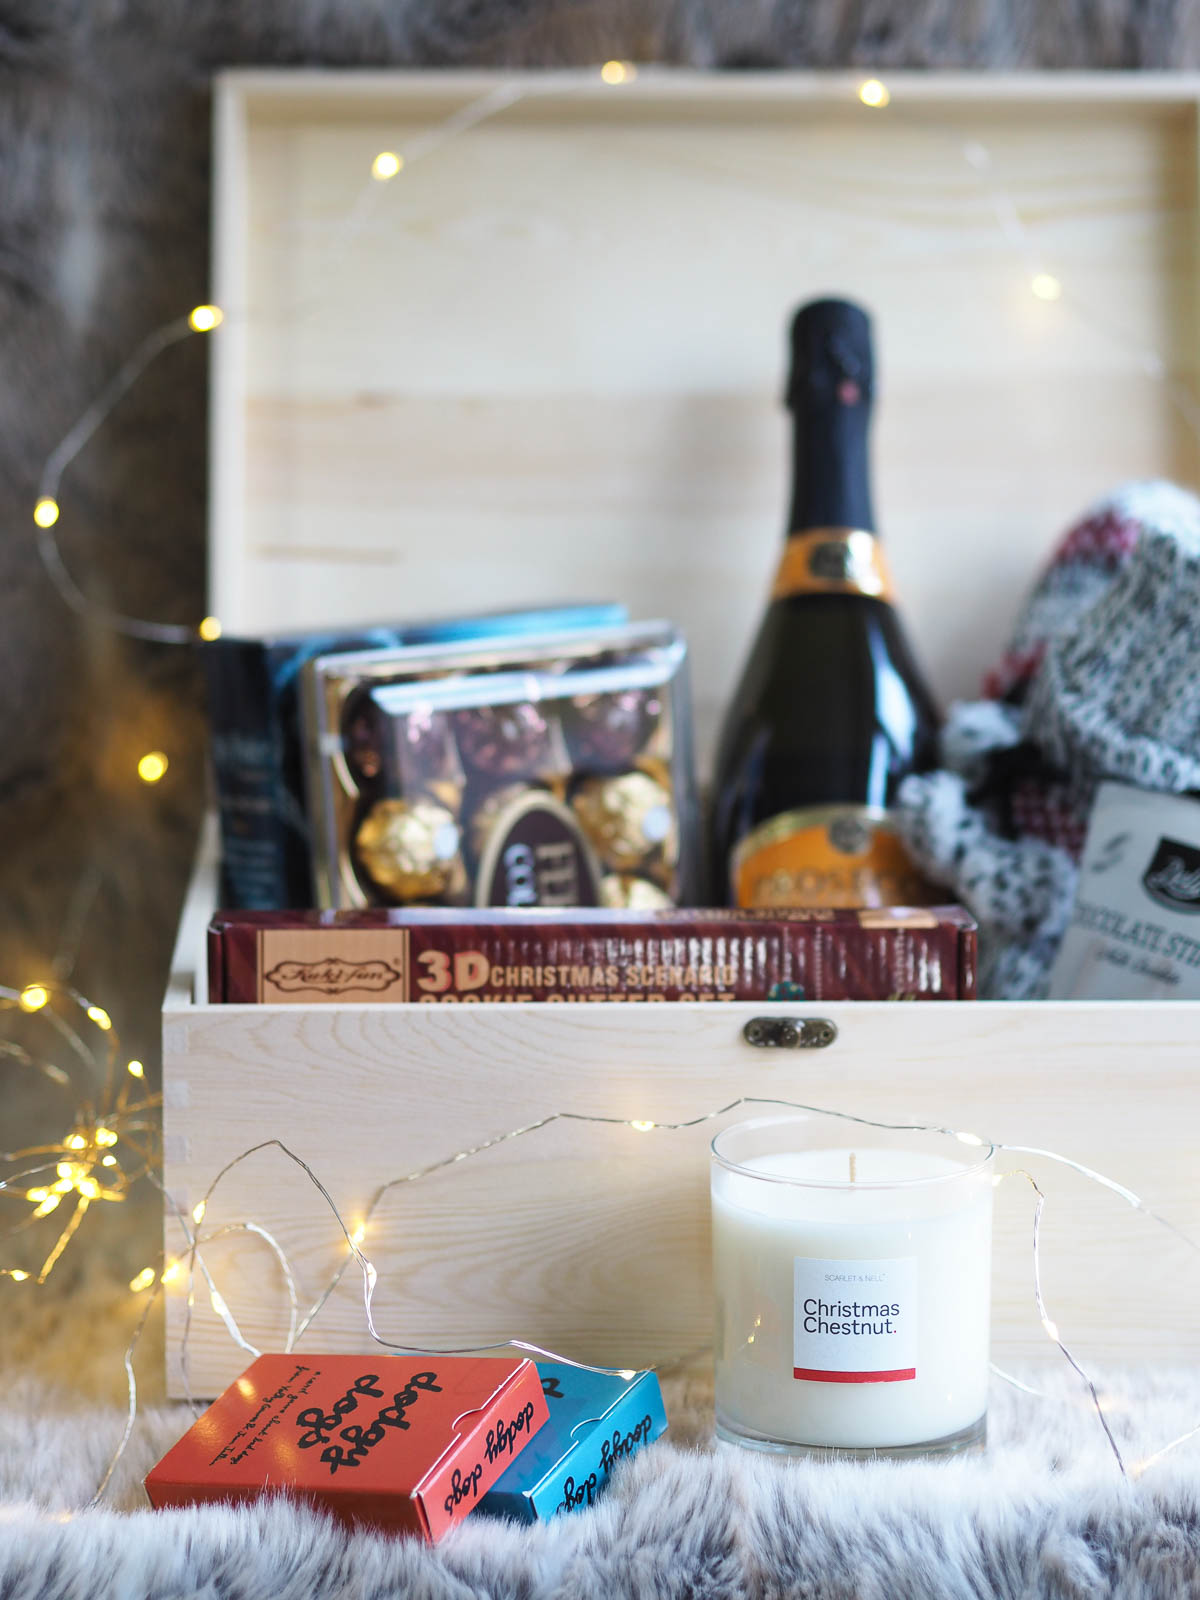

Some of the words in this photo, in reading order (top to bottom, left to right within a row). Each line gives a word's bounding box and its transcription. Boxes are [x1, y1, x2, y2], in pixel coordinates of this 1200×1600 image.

[416, 950, 490, 993] 3D
[490, 965, 619, 988] CHRISTMAS
[626, 964, 739, 987] SCENARIO
[824, 1274, 857, 1282] SCARLET
[803, 1298, 900, 1318] Christmas
[803, 1316, 897, 1336] Chestnut.
[288, 1365, 310, 1383] from
[280, 1393, 299, 1414] game
[295, 1374, 384, 1449] dogs
[258, 1415, 281, 1436] about
[320, 1371, 443, 1475] dodgy
[484, 1401, 534, 1464] dodgy
[598, 1414, 652, 1474] dodgy
[444, 1463, 483, 1516] dogs
